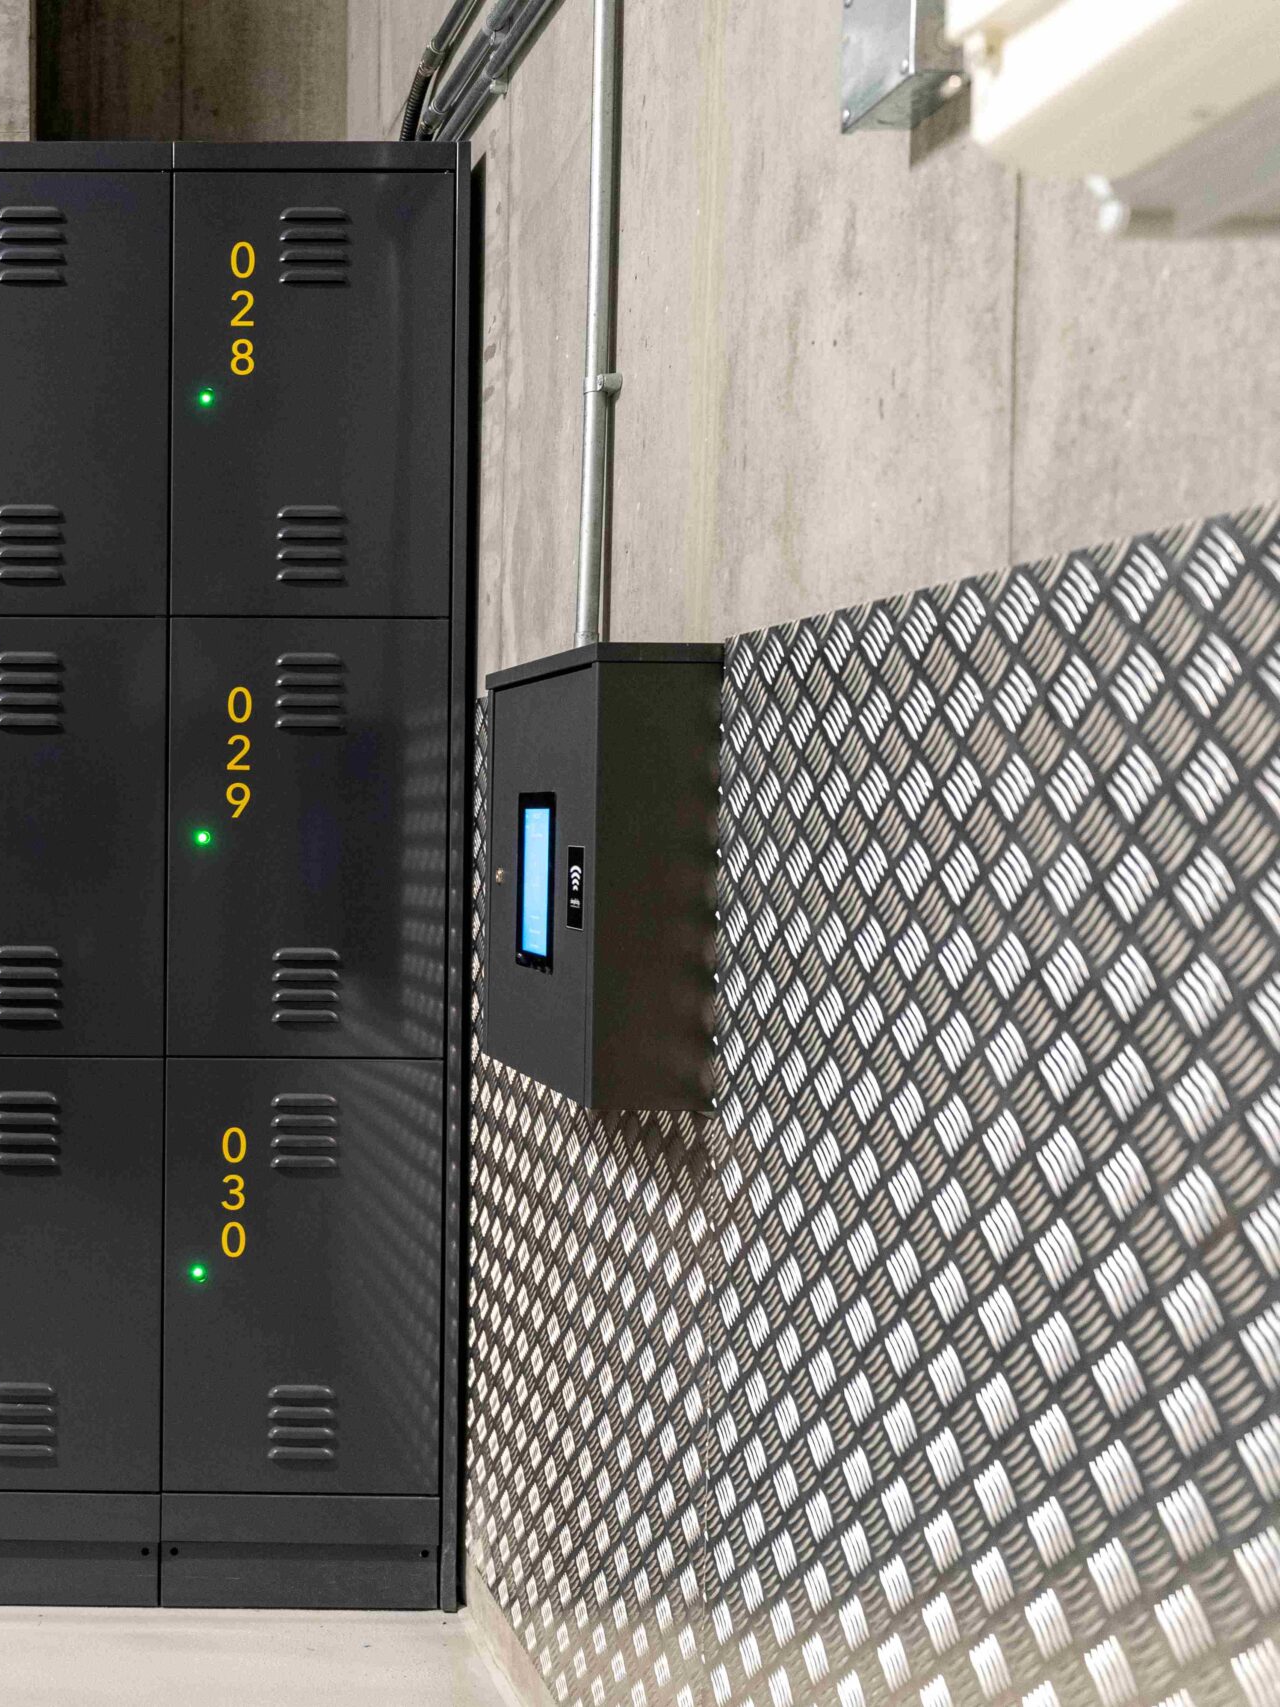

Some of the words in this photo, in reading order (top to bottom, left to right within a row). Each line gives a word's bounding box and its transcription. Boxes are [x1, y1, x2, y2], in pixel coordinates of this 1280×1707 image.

[229, 240, 256, 377] 028
[225, 685, 253, 819] 029
[220, 1126, 248, 1259] 030
